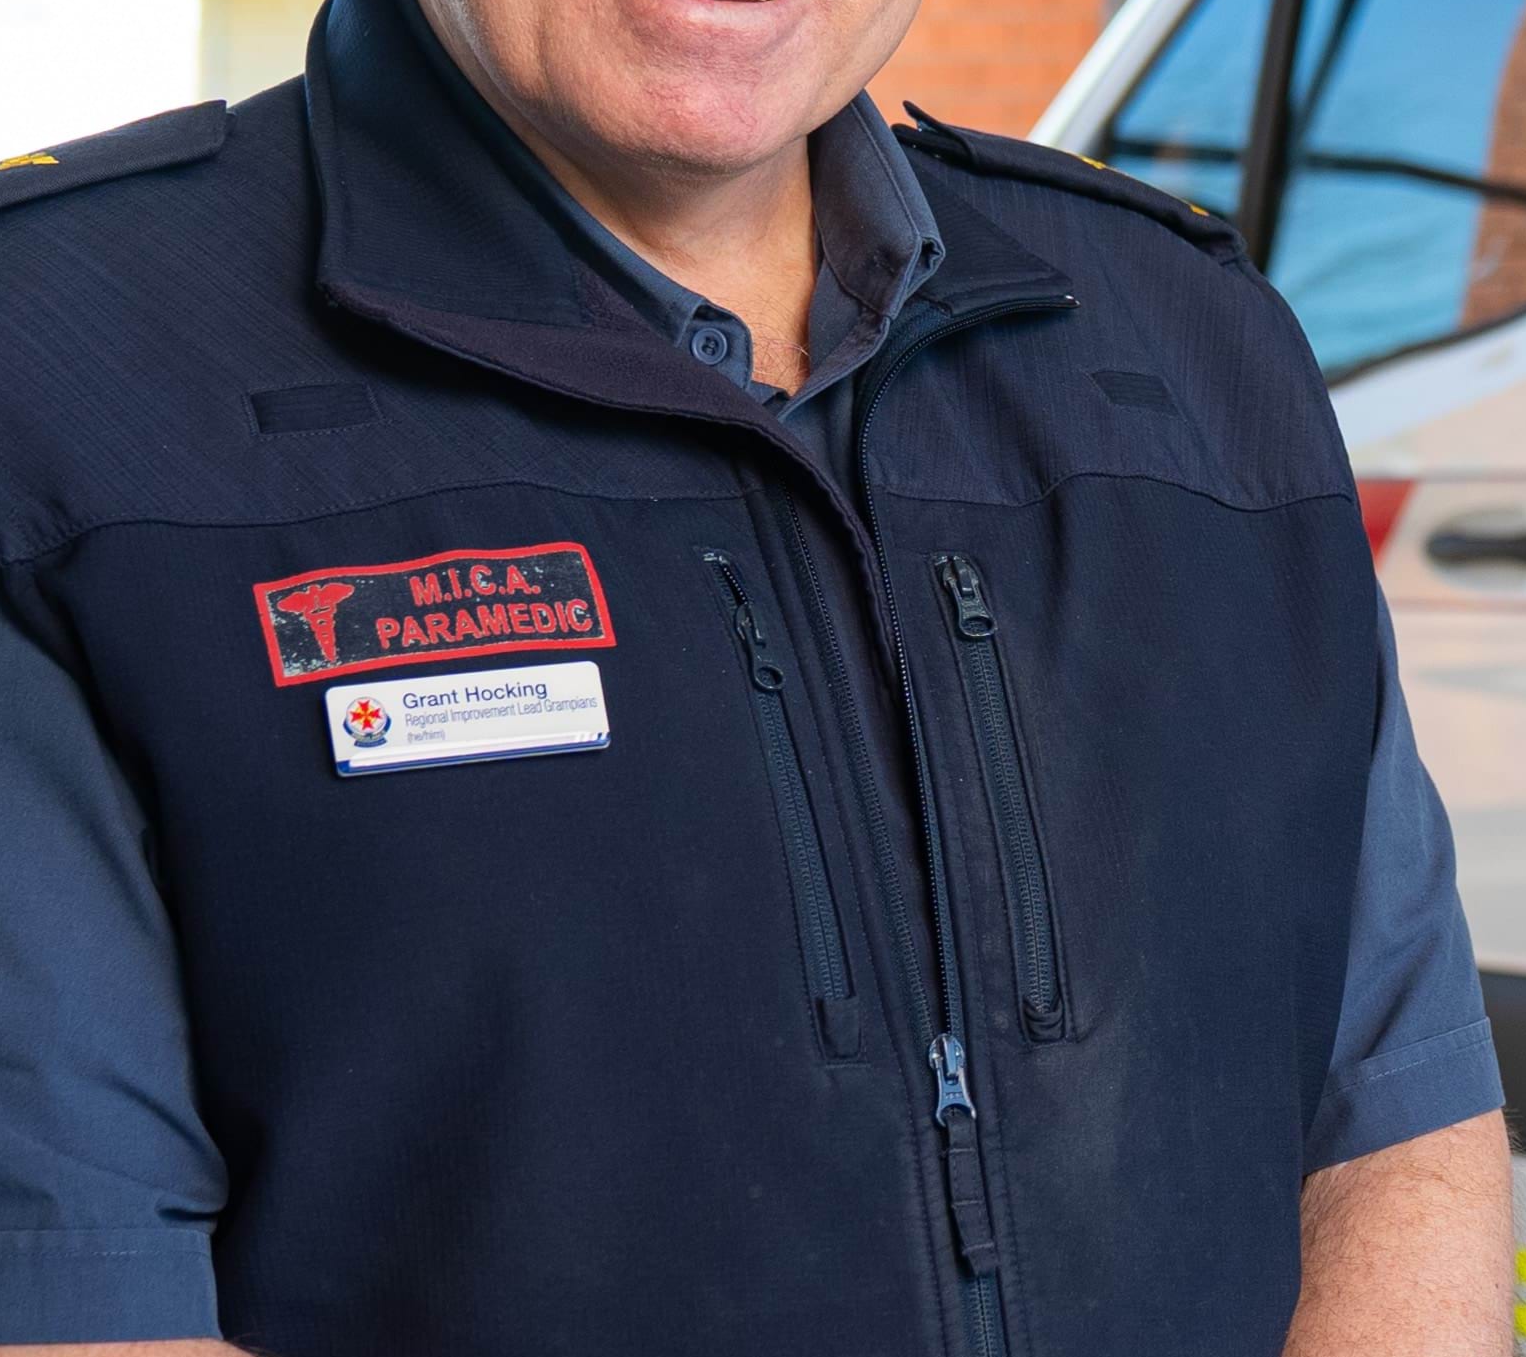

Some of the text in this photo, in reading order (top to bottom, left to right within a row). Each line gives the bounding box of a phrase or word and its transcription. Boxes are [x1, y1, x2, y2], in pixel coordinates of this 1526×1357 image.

[409, 564, 542, 607] M.I.C.A.
[376, 598, 593, 649] PARAMEDIC
[402, 682, 548, 709] Grant Hocking
[405, 695, 598, 728] Regional Improvement Lead Grampians
